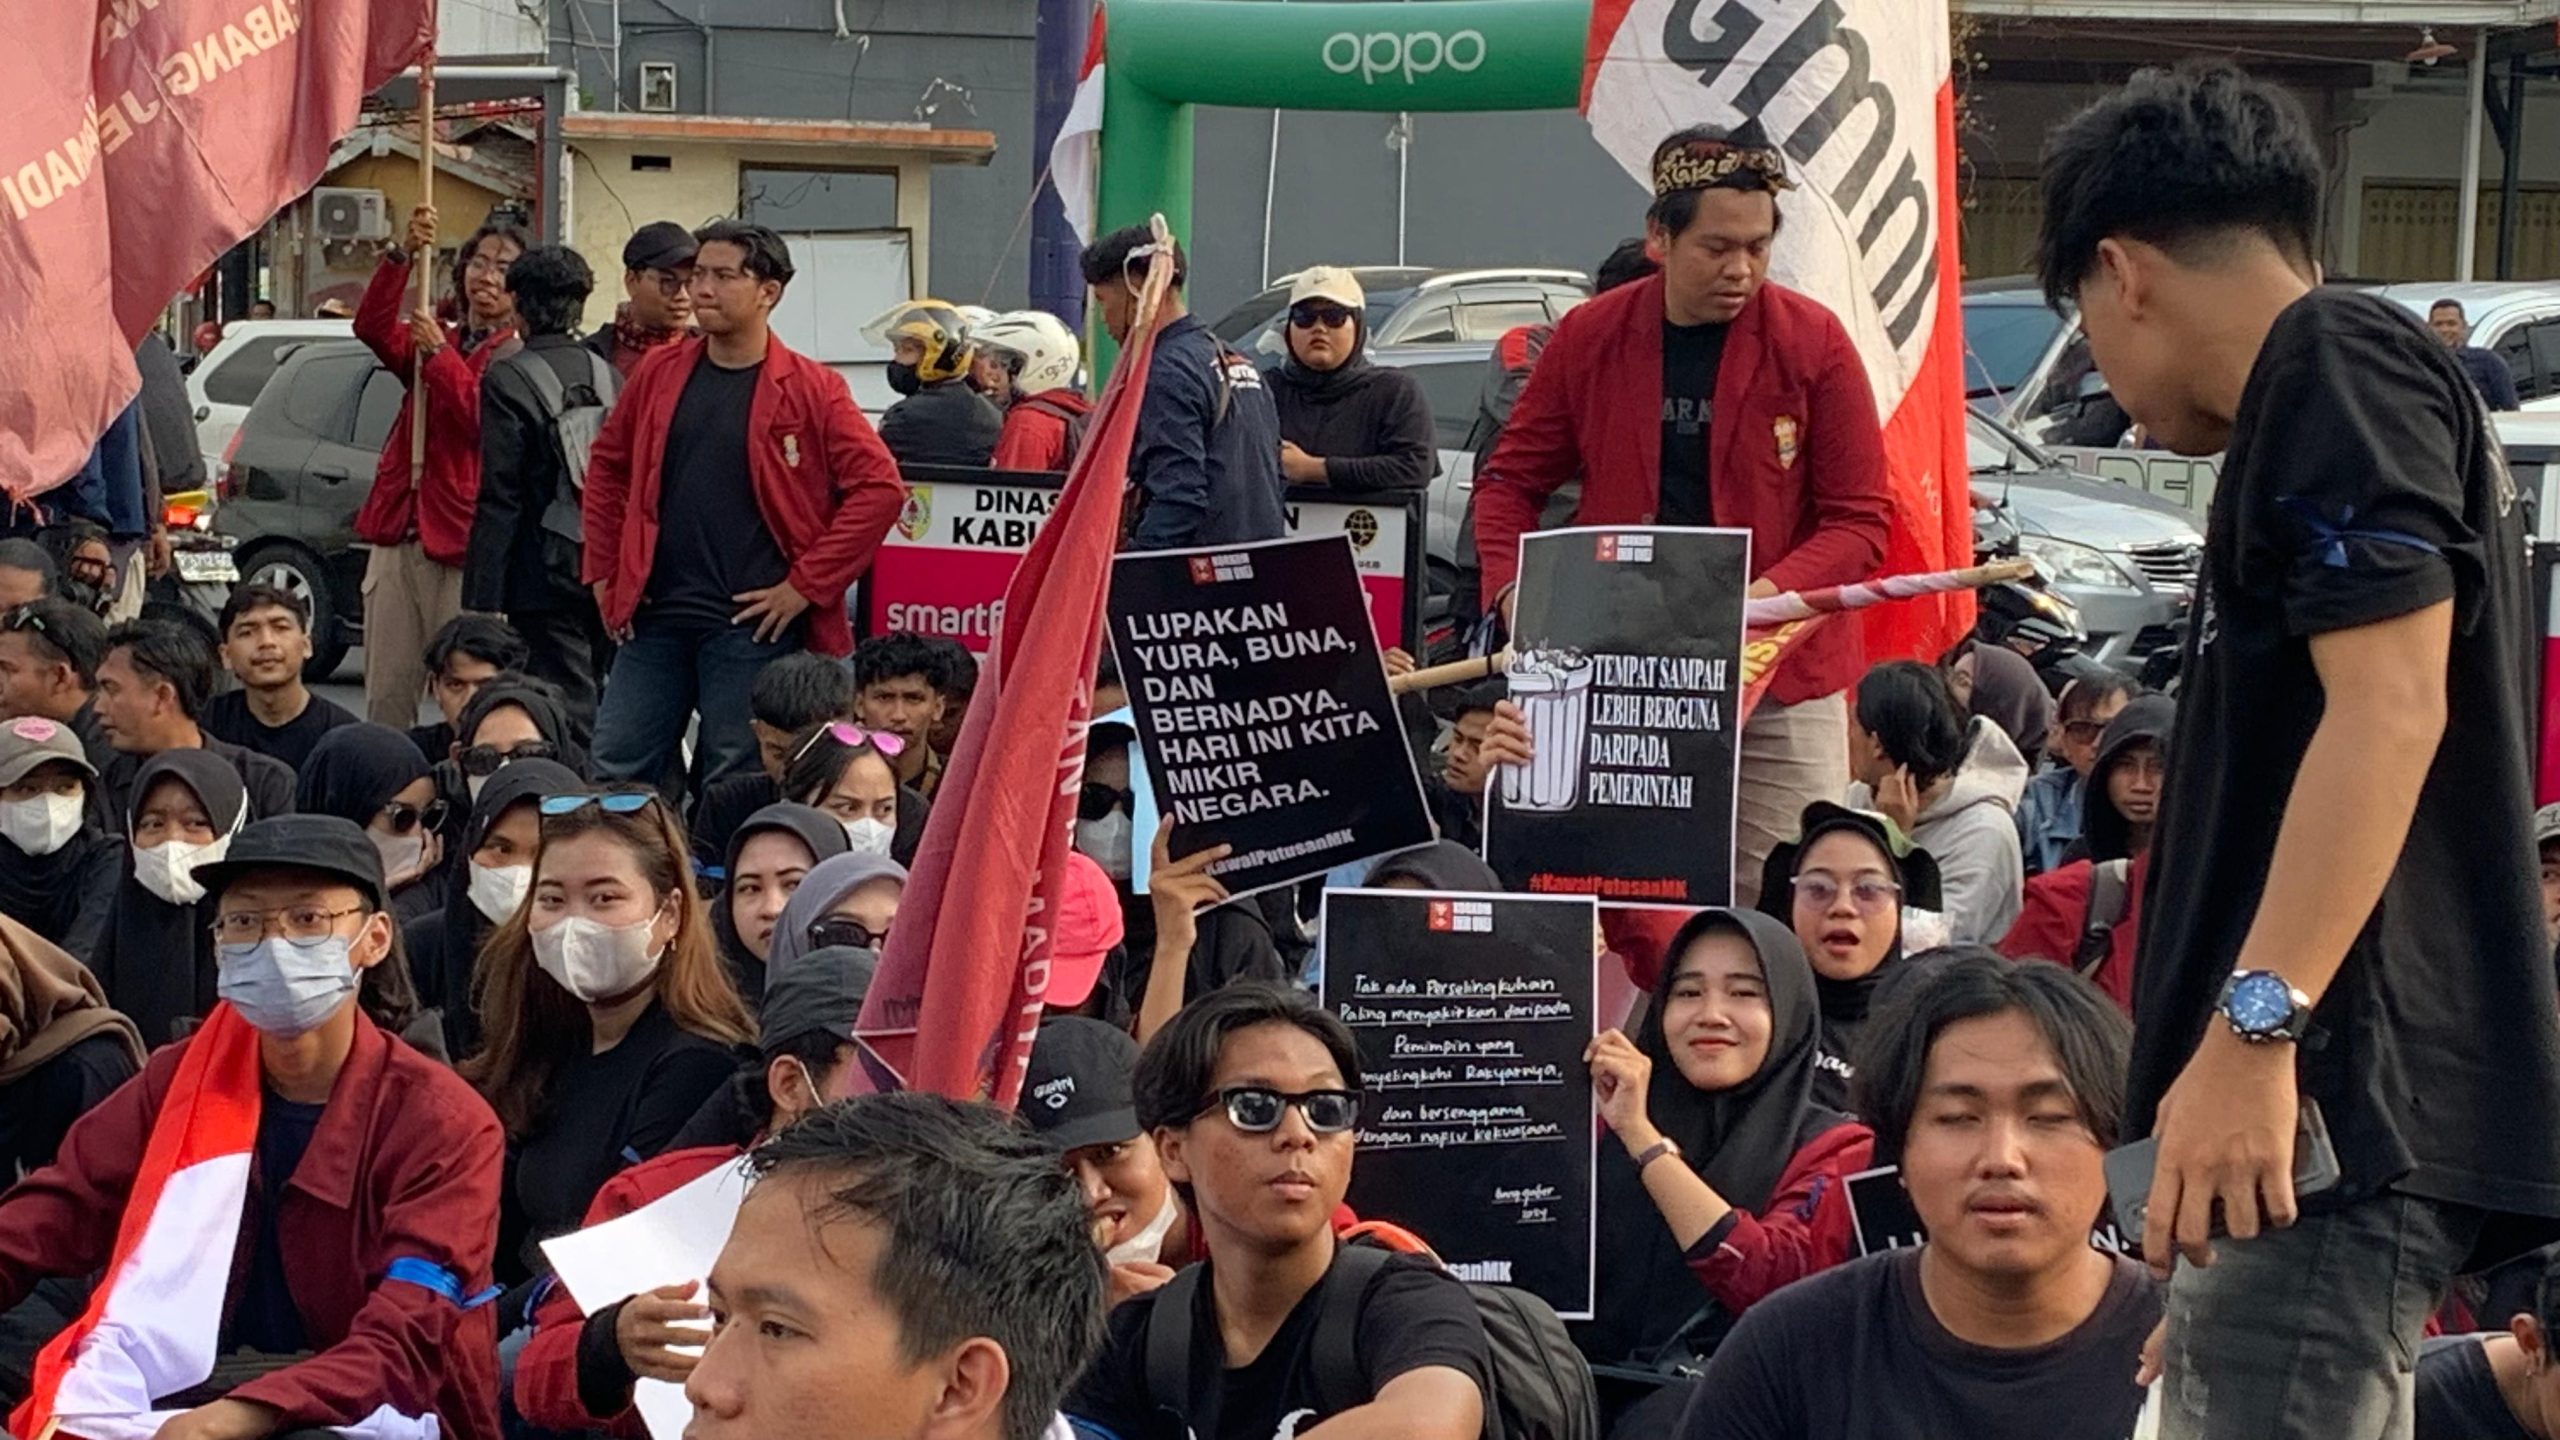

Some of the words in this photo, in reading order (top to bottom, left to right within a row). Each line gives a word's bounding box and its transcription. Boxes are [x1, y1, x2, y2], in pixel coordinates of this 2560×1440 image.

[1322, 29, 1486, 86] oppo
[887, 599, 1005, 637] smartf
[1126, 602, 1289, 641] LUPAKAN
[1133, 640, 1240, 672] YURA,
[1245, 626, 1357, 663] BUNA,
[1143, 673, 1216, 703] DAN
[1593, 653, 1659, 688] TEMPAT
[1658, 656, 1728, 692] SAMPAH
[1150, 688, 1348, 734] BERNADYA.
[1591, 692, 1641, 727] LEBIH
[1643, 695, 1721, 731] BERGUNA
[1158, 733, 1241, 765] HARI
[1246, 725, 1294, 755] INI
[1300, 710, 1380, 745] KITA
[1589, 732, 1671, 768] DARIPADA
[1166, 761, 1263, 795] MIKIR
[1587, 771, 1694, 808] PEMERINTAH
[1173, 778, 1330, 825] NEGARA.
[1202, 827, 1356, 877] KawalPutusanMK
[1529, 872, 1688, 899] #KawalPutusanMK
[1354, 973, 1381, 994] Tak
[1384, 979, 1417, 994] ada
[1394, 1034, 1472, 1056] Pemimpin
[1475, 1040, 1515, 1057] yang
[1381, 1105, 1413, 1122] dan
[1446, 1260, 1513, 1283] sanMK
